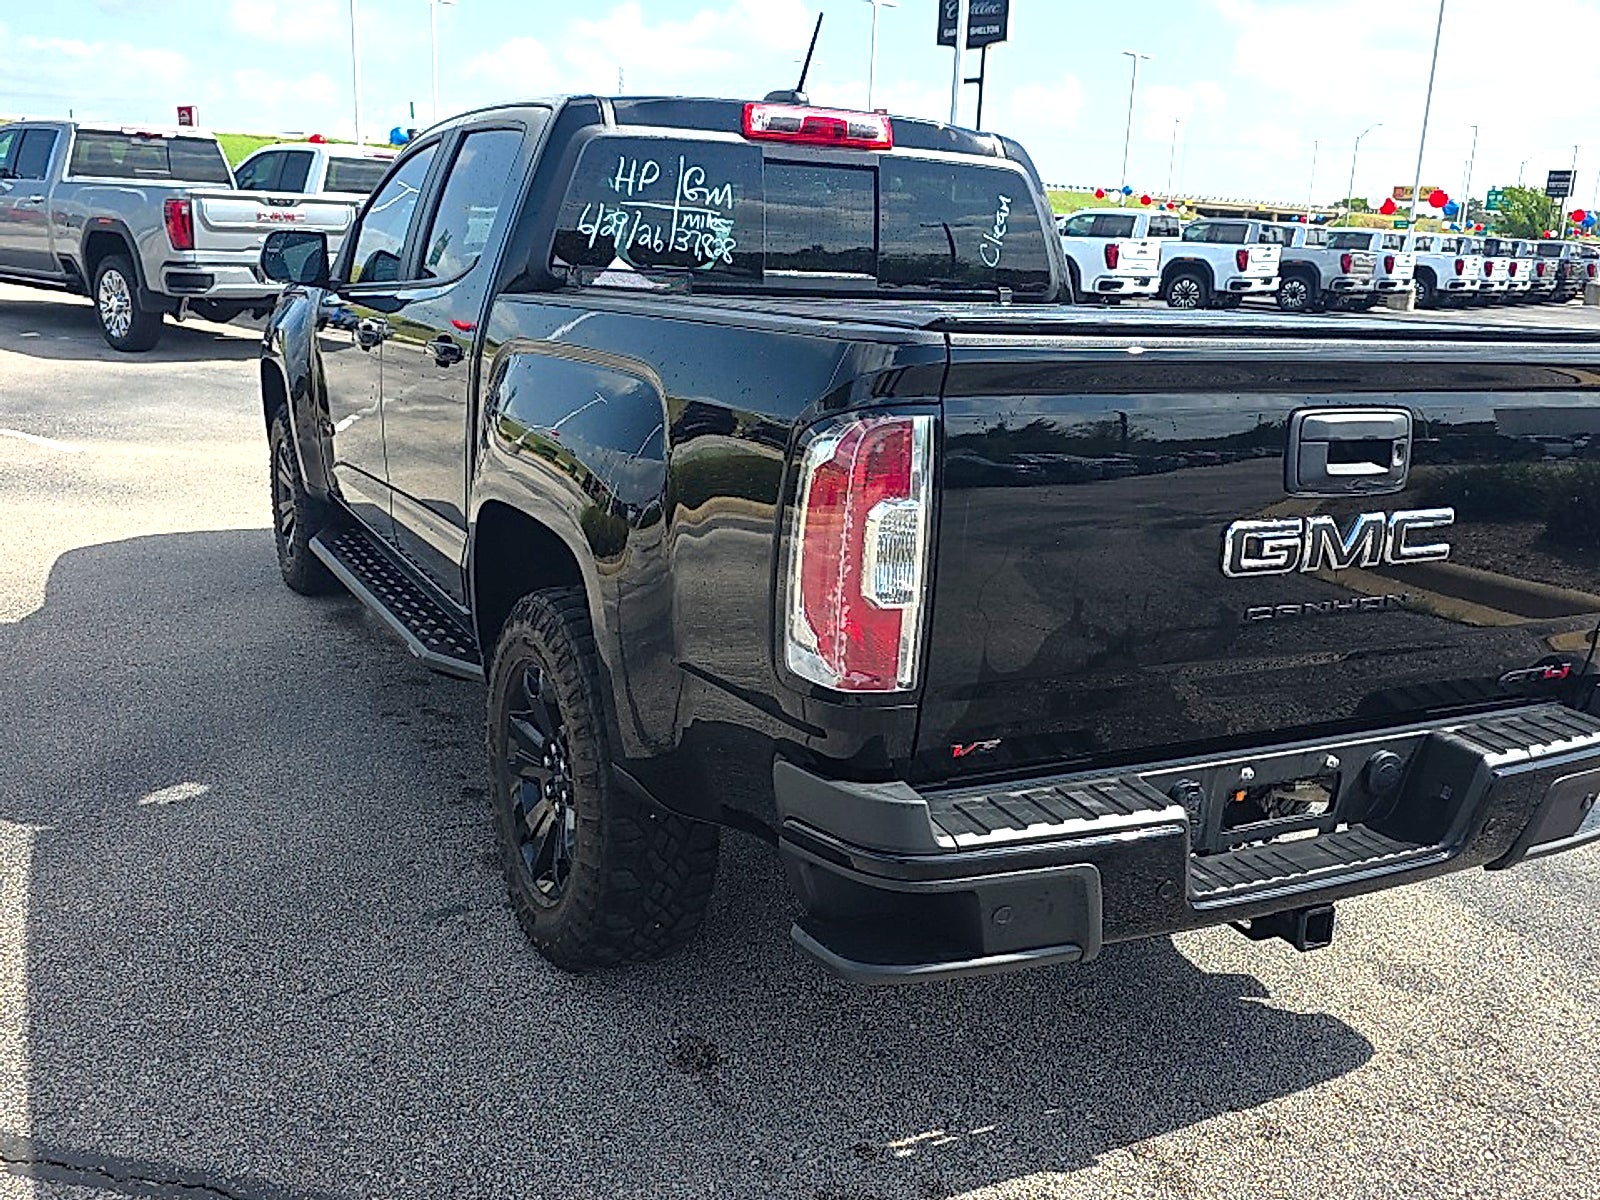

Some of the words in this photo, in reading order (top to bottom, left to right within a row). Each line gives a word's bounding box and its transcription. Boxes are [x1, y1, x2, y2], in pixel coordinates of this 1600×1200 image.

[615, 156, 660, 196] HP
[1222, 507, 1455, 578] GMC
[1244, 594, 1410, 621] CANYON
